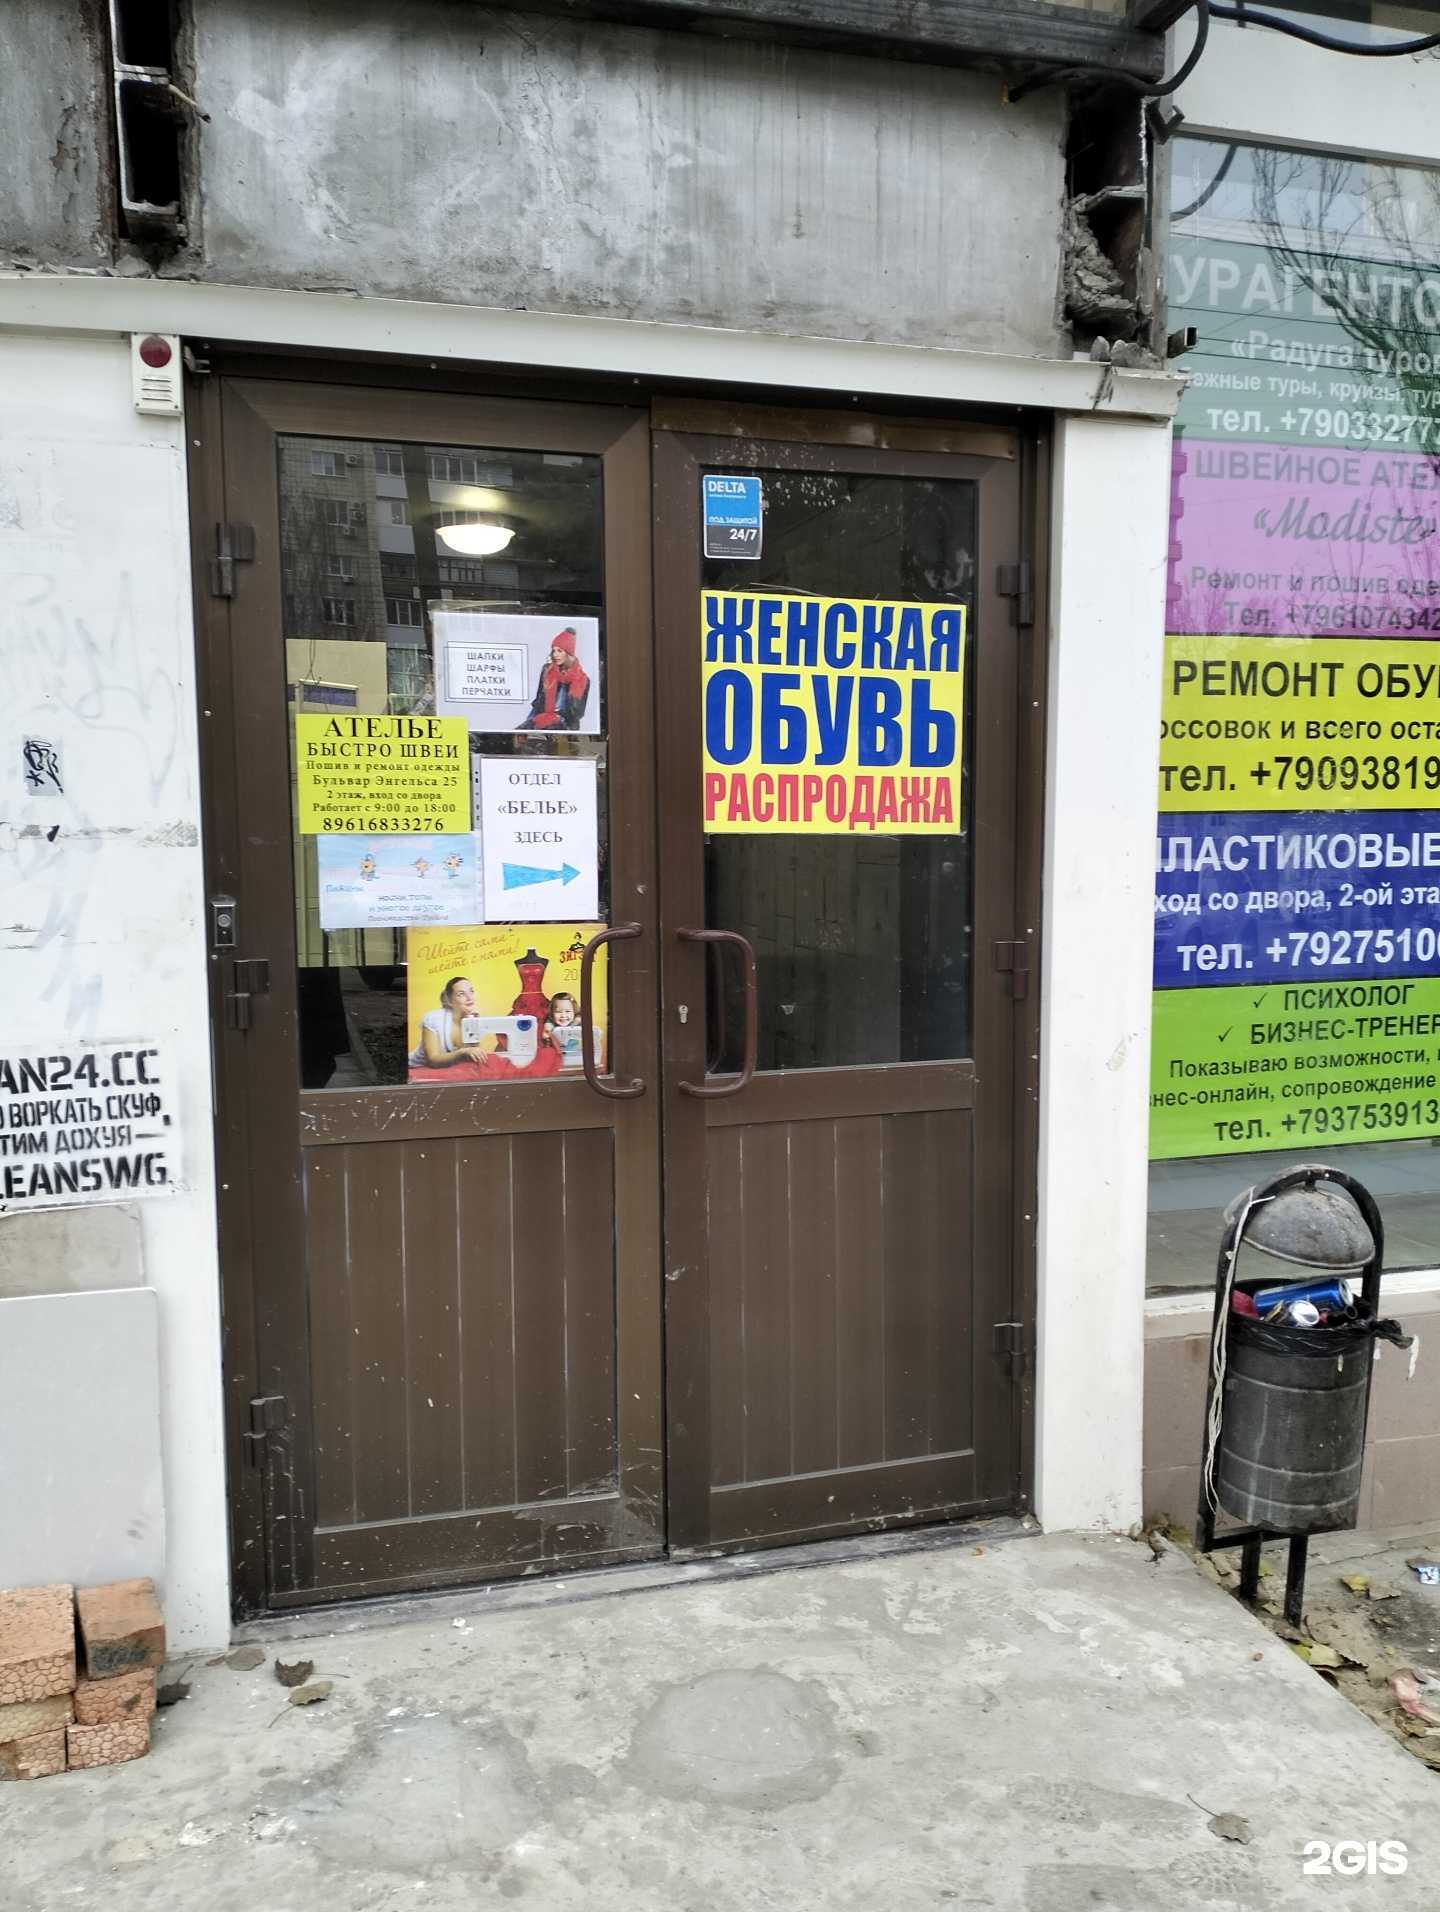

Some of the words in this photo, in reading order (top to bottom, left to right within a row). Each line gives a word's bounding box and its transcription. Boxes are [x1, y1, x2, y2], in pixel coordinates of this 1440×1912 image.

[1231, 330, 1353, 371] «Радуга
[1268, 376, 1322, 398] туры,
[1329, 381, 1404, 404] круизы,
[1207, 408, 1269, 433] тел.
[1195, 444, 1361, 487] ШВЕЙНОЕ
[1370, 459, 1440, 491] АТЕ
[708, 481, 746, 494] DELTA
[729, 528, 758, 542] 24/7
[1190, 565, 1282, 591] Ремонт
[1289, 576, 1303, 592] и
[1311, 575, 1389, 594] пошив
[1224, 600, 1276, 628] Тел.
[705, 596, 961, 673] ЖЕНСКАЯ
[466, 664, 506, 672] ШАРФЫ
[467, 652, 505, 661] ШАПКИ
[466, 675, 506, 685] ПЛАТКИ
[1173, 659, 1345, 697] РЕМОНТ
[1356, 663, 1440, 699] ОБУ
[462, 687, 512, 697] ПЕРЧАТКИ
[324, 717, 443, 739] АТЕЛЬЕ
[705, 669, 956, 768] ОБУВЬ
[1280, 720, 1296, 739] и
[1305, 720, 1382, 740] всего
[307, 742, 392, 757] БЫСТРО
[400, 744, 459, 759] ШВЕИ
[306, 760, 349, 770] Пошив
[366, 763, 409, 773] ремонт
[414, 763, 460, 772] одежды
[1160, 764, 1236, 792] тел.
[313, 774, 370, 788] Бульвар
[375, 775, 438, 786] Энгельса
[443, 776, 458, 787] 25
[509, 773, 561, 786] ОТДЕЛ
[313, 803, 361, 812] Работает
[374, 803, 400, 812] 9:00
[405, 805, 419, 813] до
[424, 803, 456, 813] 18:00
[327, 790, 333, 799] 2
[336, 792, 366, 800] этаж,
[369, 792, 393, 800] вход
[411, 793, 442, 802] двора
[497, 801, 578, 815] «БЕЛЬЕ»
[704, 772, 954, 831] РАСПРОДАЖА
[323, 818, 444, 831] 89616833276
[513, 831, 563, 844] ЗДЕСЬ
[1208, 892, 1239, 911] со
[1244, 889, 1332, 914] двора,
[1339, 882, 1393, 907] 2-ой
[1177, 943, 1254, 971] тел.
[1266, 928, 1440, 967] +7927510
[1283, 984, 1415, 1011] ПСИХОЛОГ
[1251, 1014, 1440, 1045] БИЗНЕС-ТРЕНЕР
[1170, 1056, 1288, 1078] Показываю
[1294, 1048, 1430, 1071] возможности,
[1149, 1084, 1275, 1107] нес-онлайн,
[1282, 1074, 1436, 1101] сопровождение
[8, 1097, 102, 1129] ВОРКАТЬ
[1214, 1118, 1271, 1142] тел.
[0, 1152, 168, 1199] EANSWG
